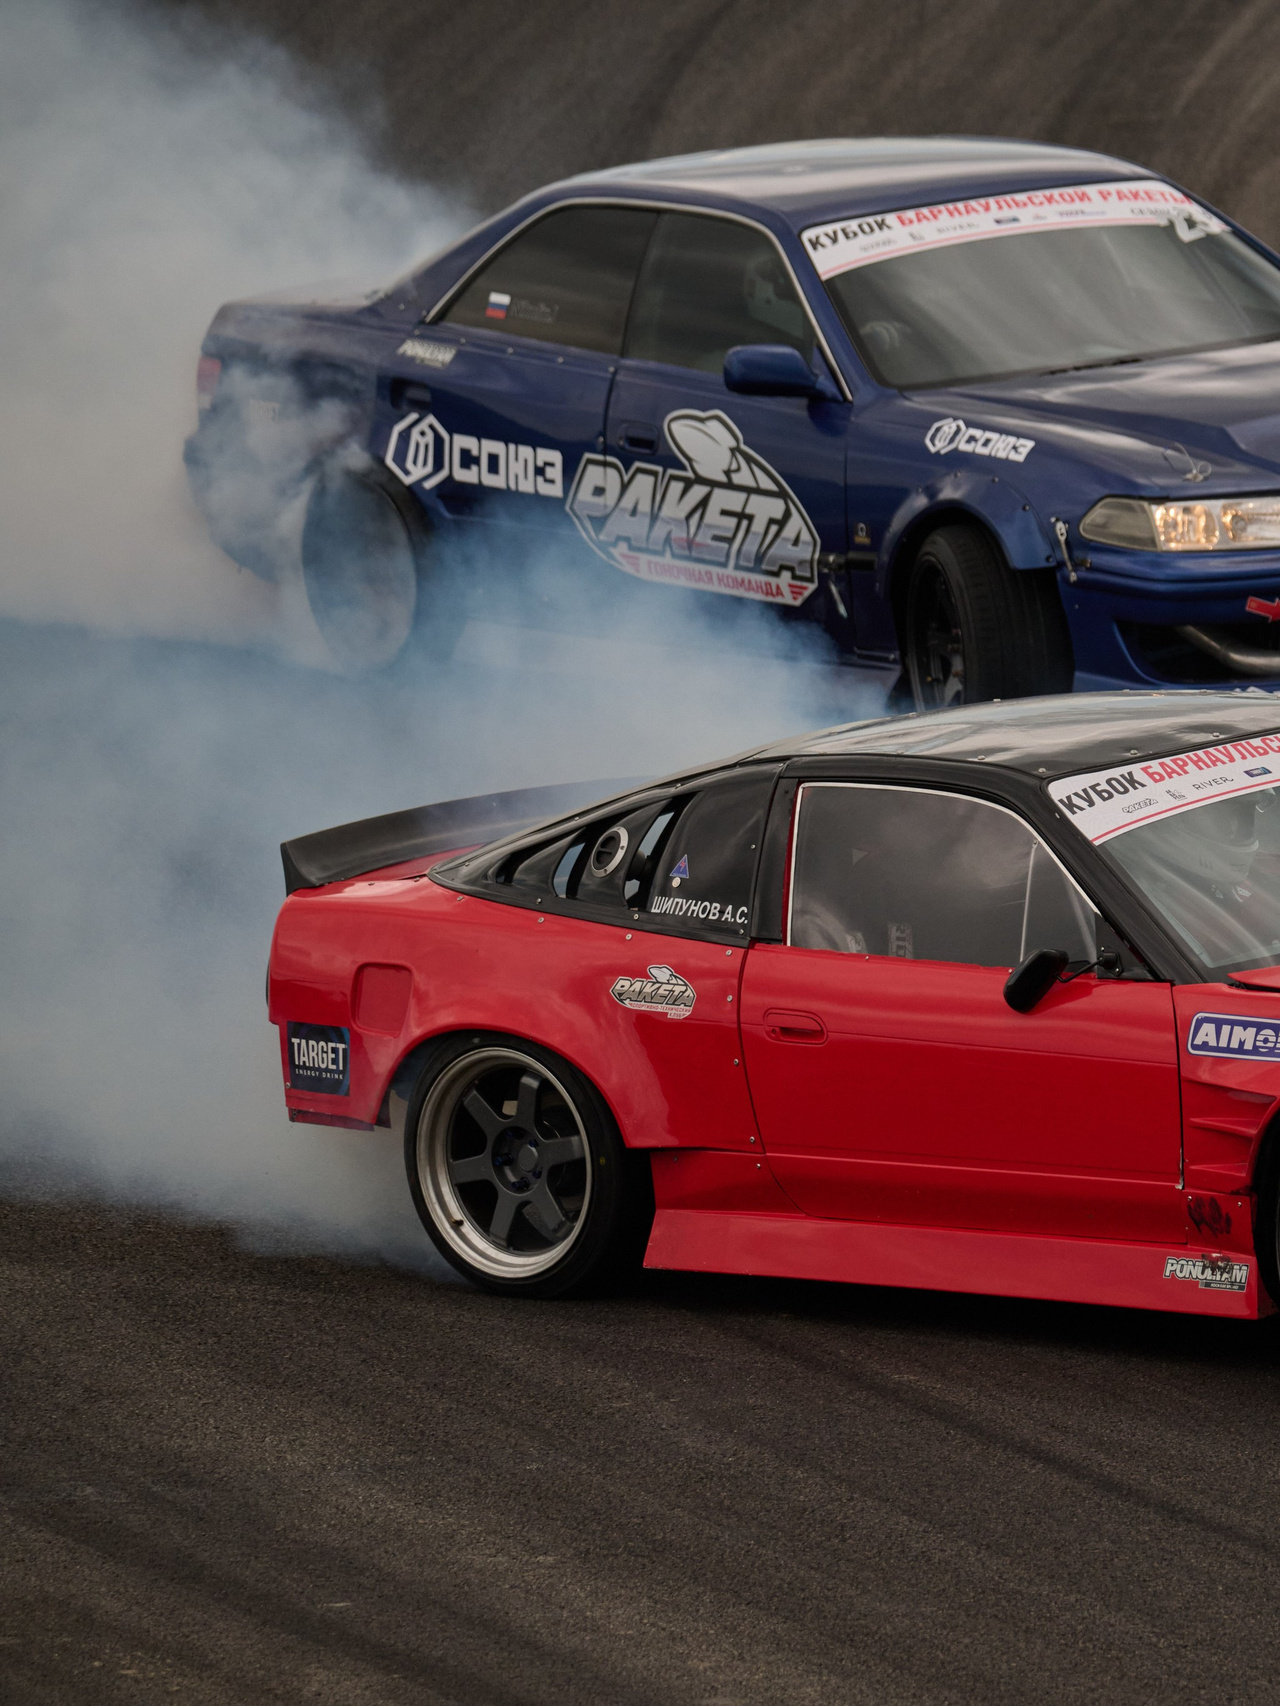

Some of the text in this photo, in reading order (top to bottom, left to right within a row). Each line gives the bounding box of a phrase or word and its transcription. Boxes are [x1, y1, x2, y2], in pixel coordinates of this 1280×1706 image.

[808, 216, 893, 251] КУБОК
[895, 189, 1092, 228] БАРНАУЛЬСКОЙ
[958, 427, 1036, 463] СОЮЗ
[452, 434, 564, 498] СОЮЗ
[575, 460, 812, 577] РАКЕТА
[647, 560, 786, 599] ГОНОЧНАЯ КОМАНДА
[1058, 771, 1147, 815] КУБОК
[1192, 776, 1234, 791] RIVER
[651, 896, 721, 920] ШИПУНОВ
[611, 978, 696, 1007] РАКЕТА
[291, 1037, 346, 1071] TARGET
[296, 1068, 344, 1080] ENERGY DRINK
